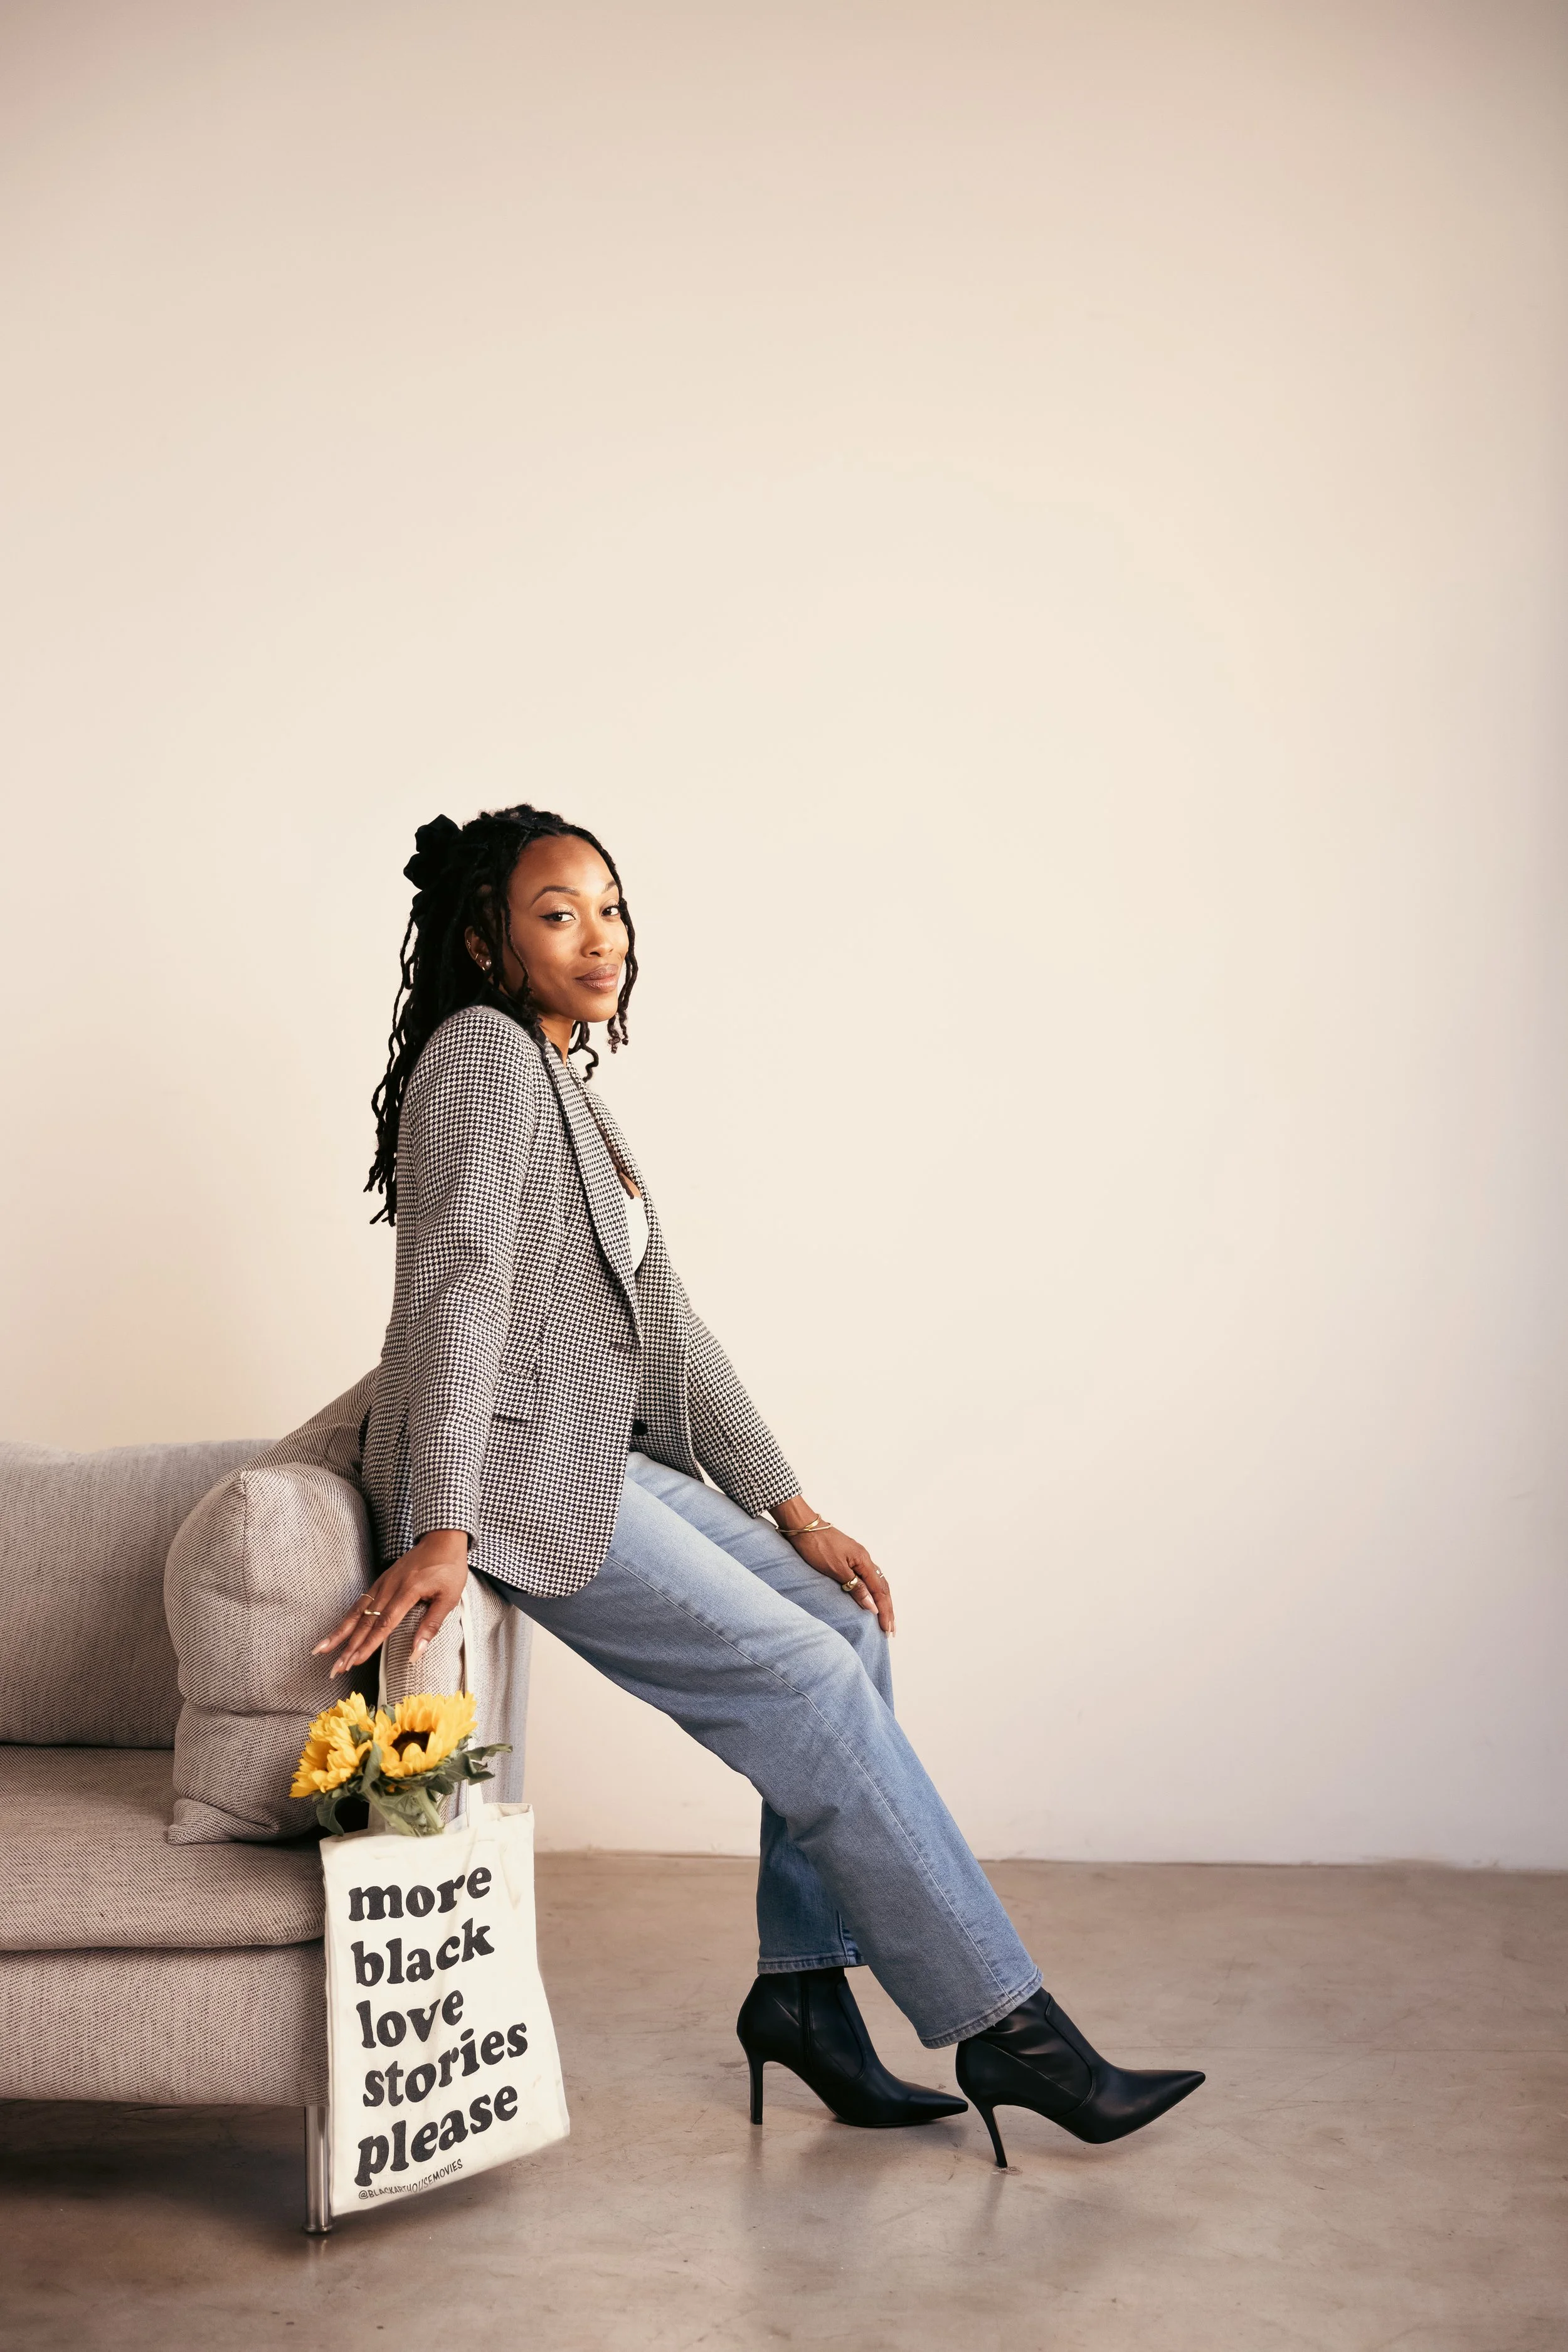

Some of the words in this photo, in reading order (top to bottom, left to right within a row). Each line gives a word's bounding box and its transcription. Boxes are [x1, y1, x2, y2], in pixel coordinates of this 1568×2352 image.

[348, 1867, 492, 1922] more
[350, 1917, 495, 1987] black
[356, 1989, 464, 2049] love
[363, 2022, 528, 2107] stories
[354, 2085, 518, 2187] please
[358, 2158, 463, 2200] @BLACKARTHOUSEMOVIES
